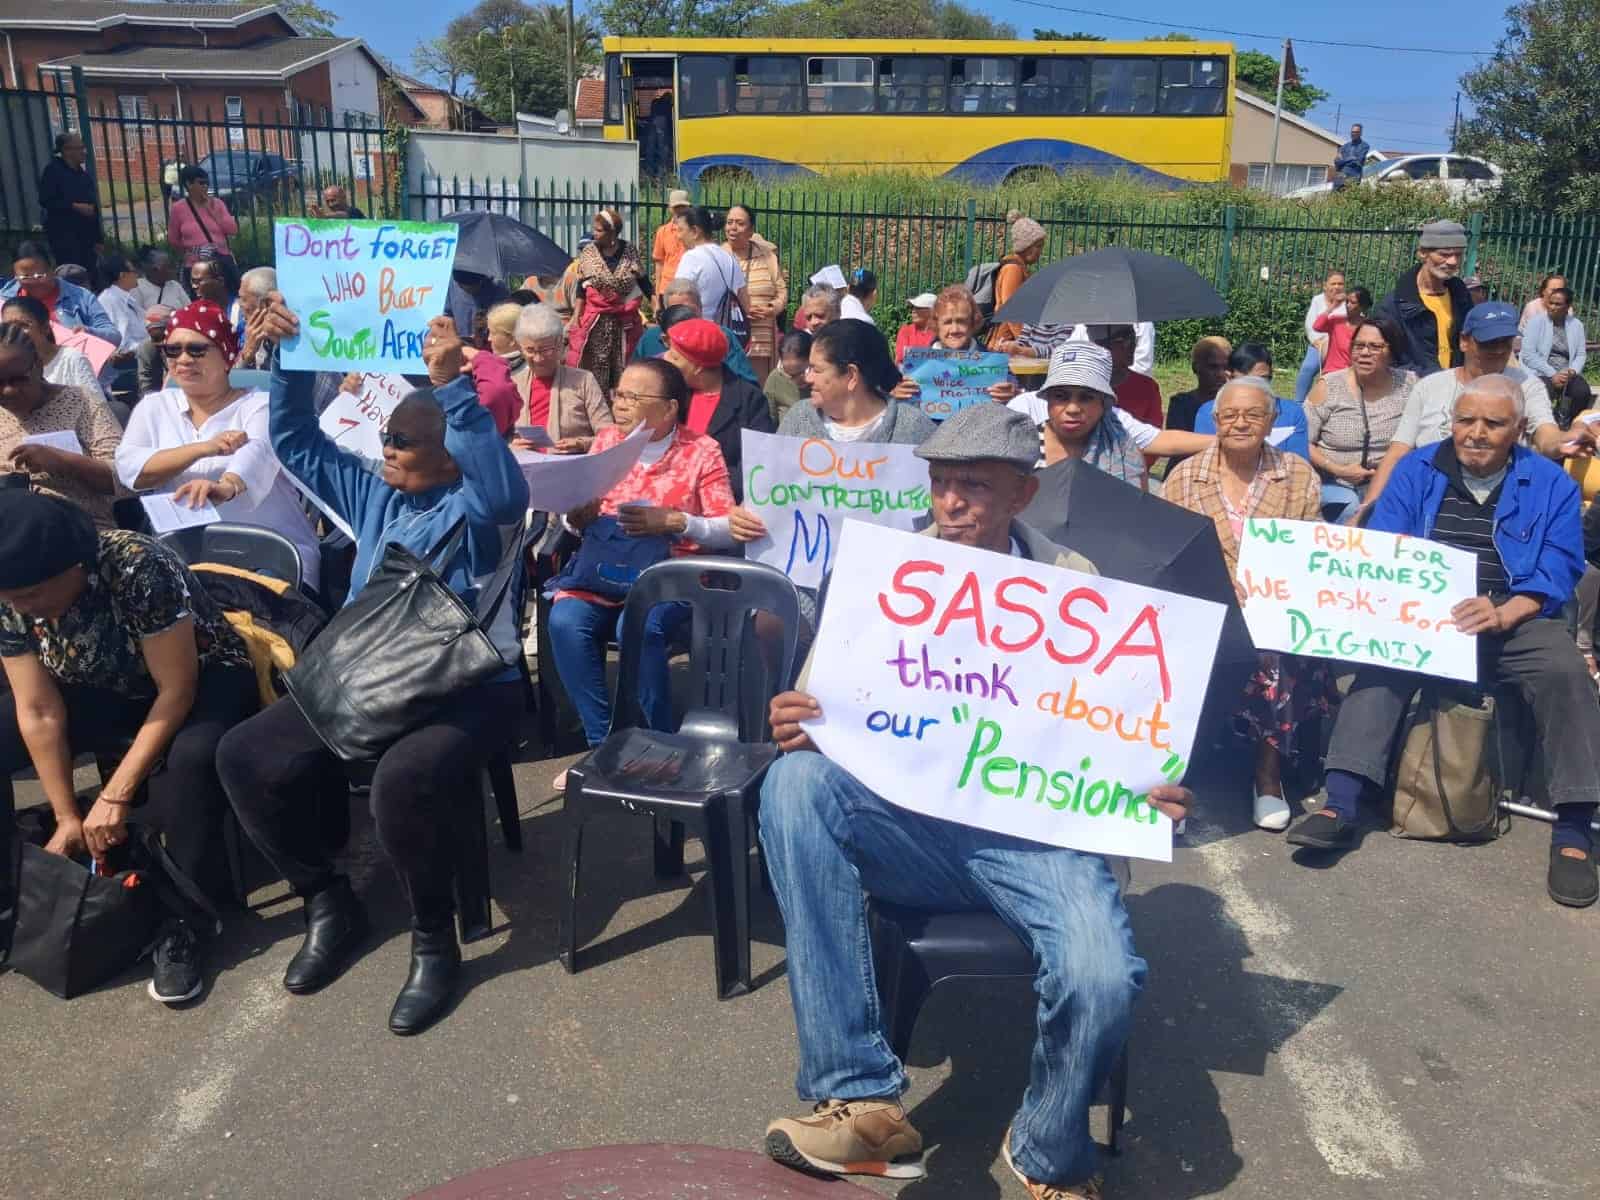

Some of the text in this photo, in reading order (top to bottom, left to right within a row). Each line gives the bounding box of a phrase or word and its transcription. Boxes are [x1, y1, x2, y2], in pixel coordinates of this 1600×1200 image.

[285, 224, 360, 260] Dont
[322, 271, 366, 302] WHO
[381, 318, 431, 360] AFRI
[800, 437, 888, 480] Our
[1244, 569, 1291, 600] WE
[878, 560, 1171, 702] SASSA
[886, 640, 1171, 750] think about
[866, 710, 940, 740] our
